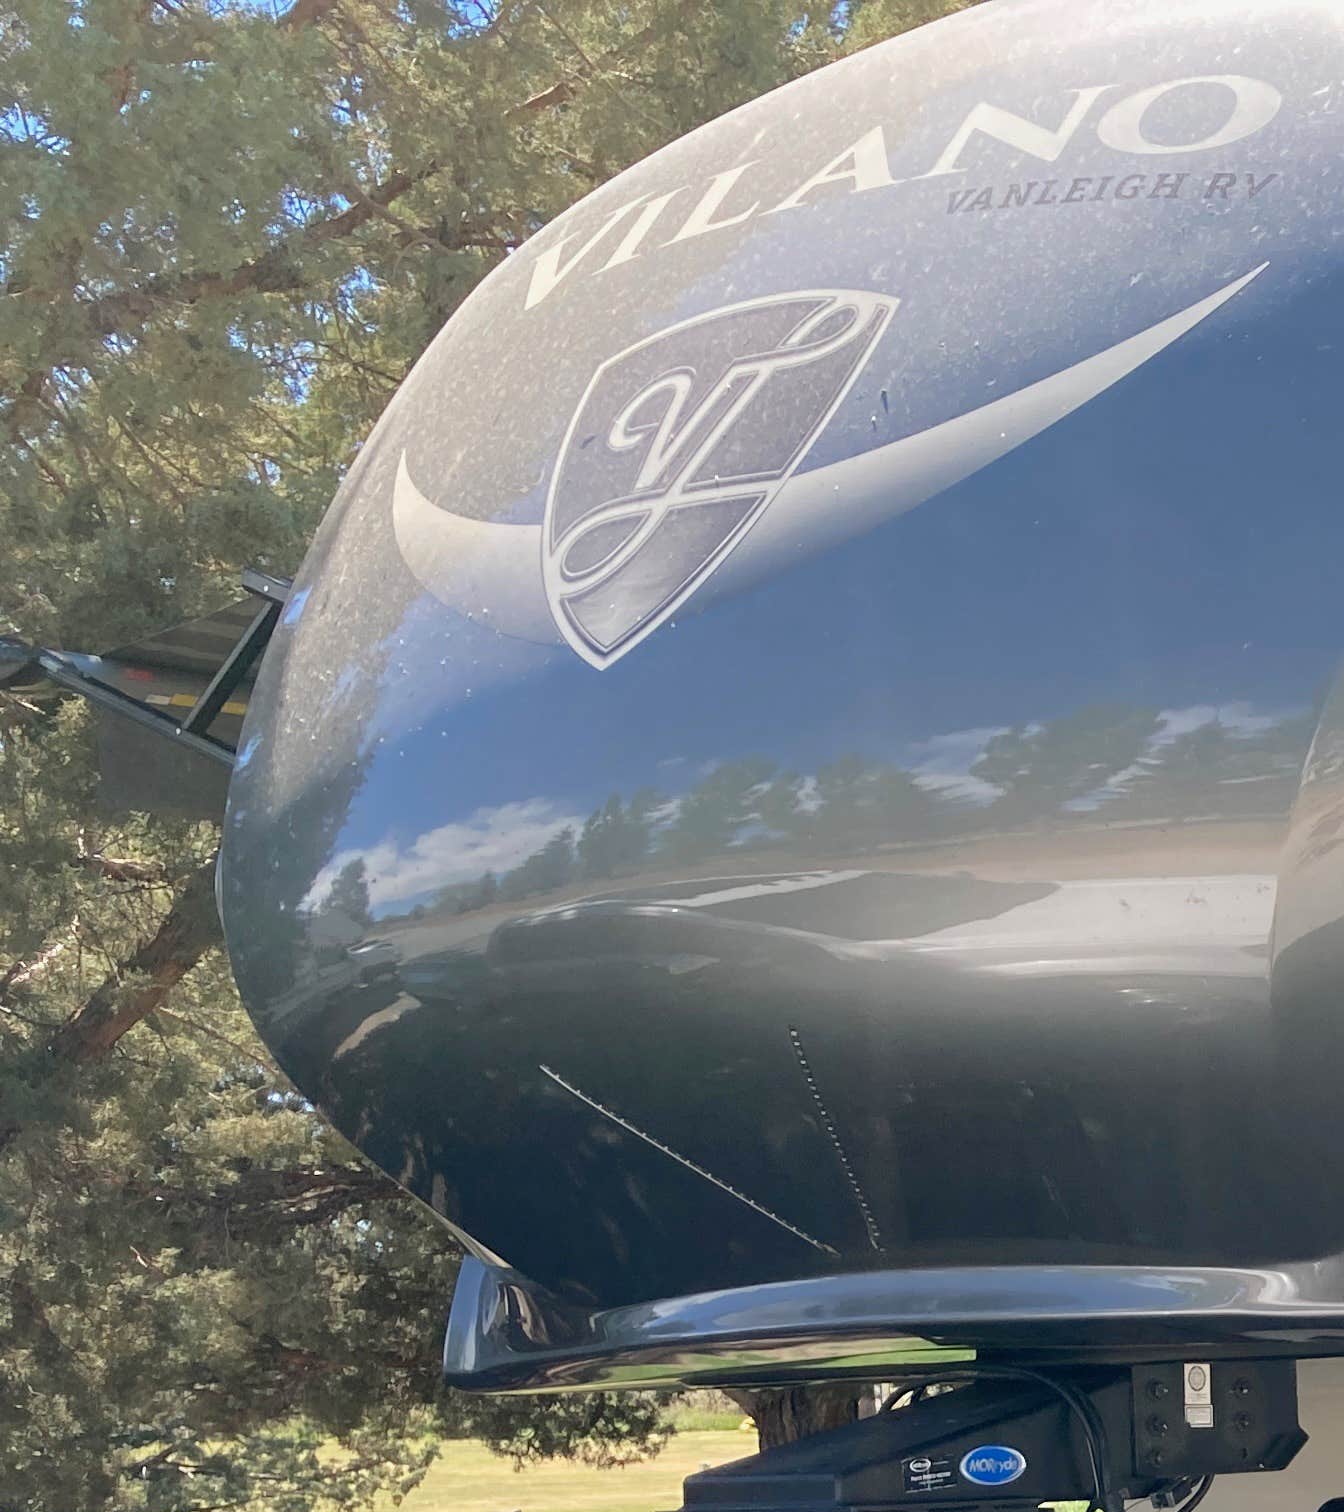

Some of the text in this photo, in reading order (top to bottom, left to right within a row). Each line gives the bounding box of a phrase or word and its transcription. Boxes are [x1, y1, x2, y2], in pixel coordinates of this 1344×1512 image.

[523, 74, 1283, 311] VILANO
[947, 172, 1278, 214] VANLEIGH RV
